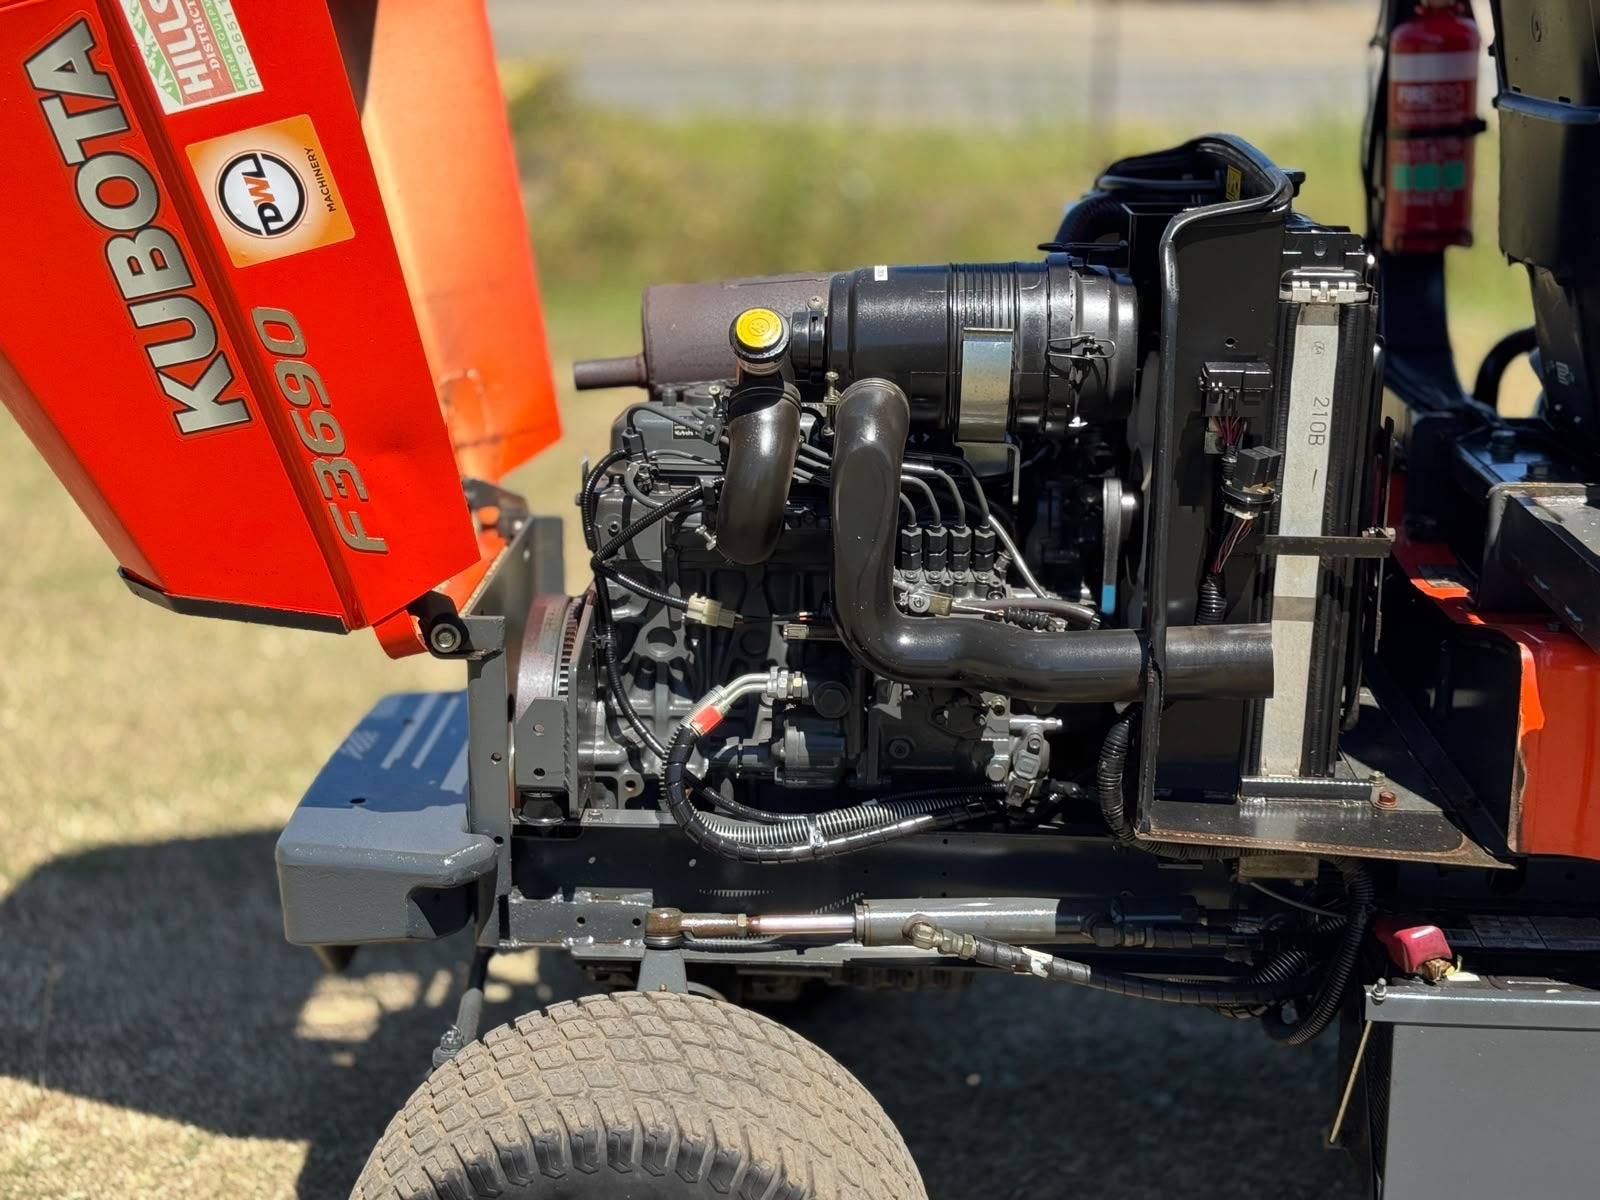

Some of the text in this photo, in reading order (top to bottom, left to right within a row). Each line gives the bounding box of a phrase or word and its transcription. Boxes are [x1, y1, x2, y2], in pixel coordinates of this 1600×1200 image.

[224, 12, 248, 55] 9651
[227, 54, 246, 90] FARM
[304, 147, 337, 213] MACHINERY
[23, 17, 252, 436] KUBOTA
[252, 306, 389, 554] F3690
[1308, 396, 1330, 446] 210B
